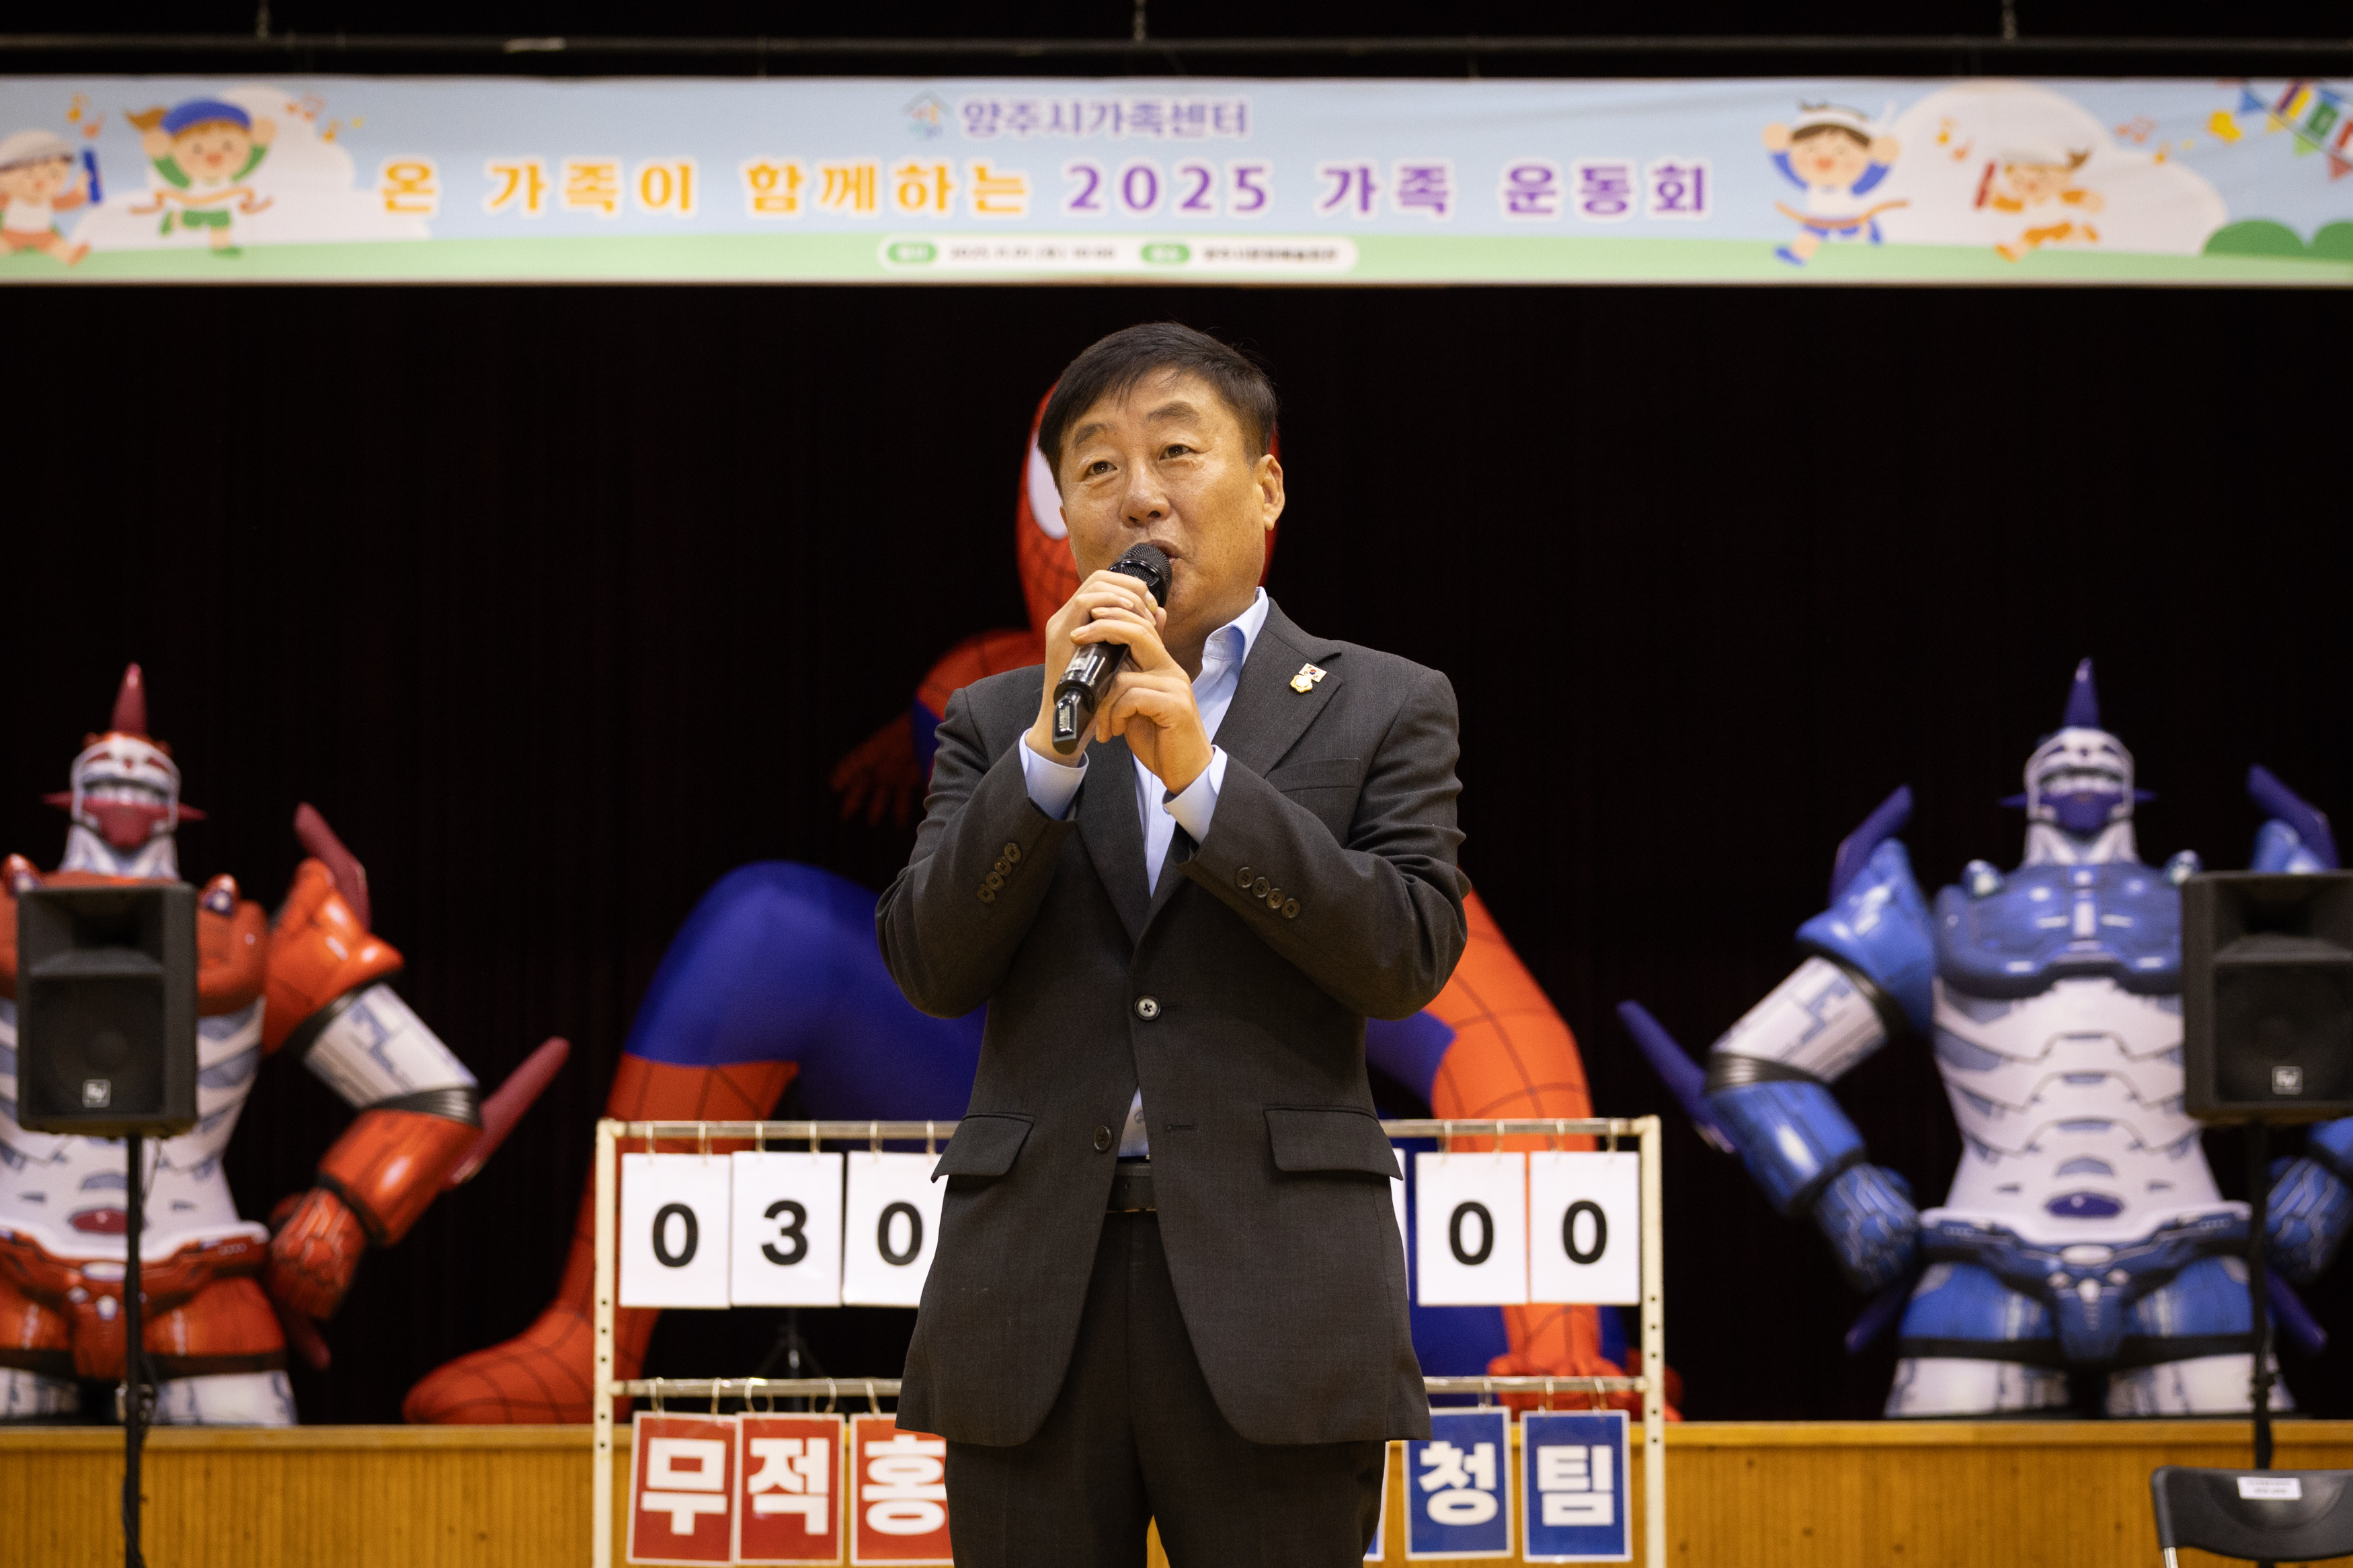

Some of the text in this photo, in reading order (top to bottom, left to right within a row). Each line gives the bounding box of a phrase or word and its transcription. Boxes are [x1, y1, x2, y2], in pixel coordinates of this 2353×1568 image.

[963, 101, 1245, 135] 양주시가족센터
[381, 161, 1703, 214] 온 가족이 함께하는 2025 가족 운동회
